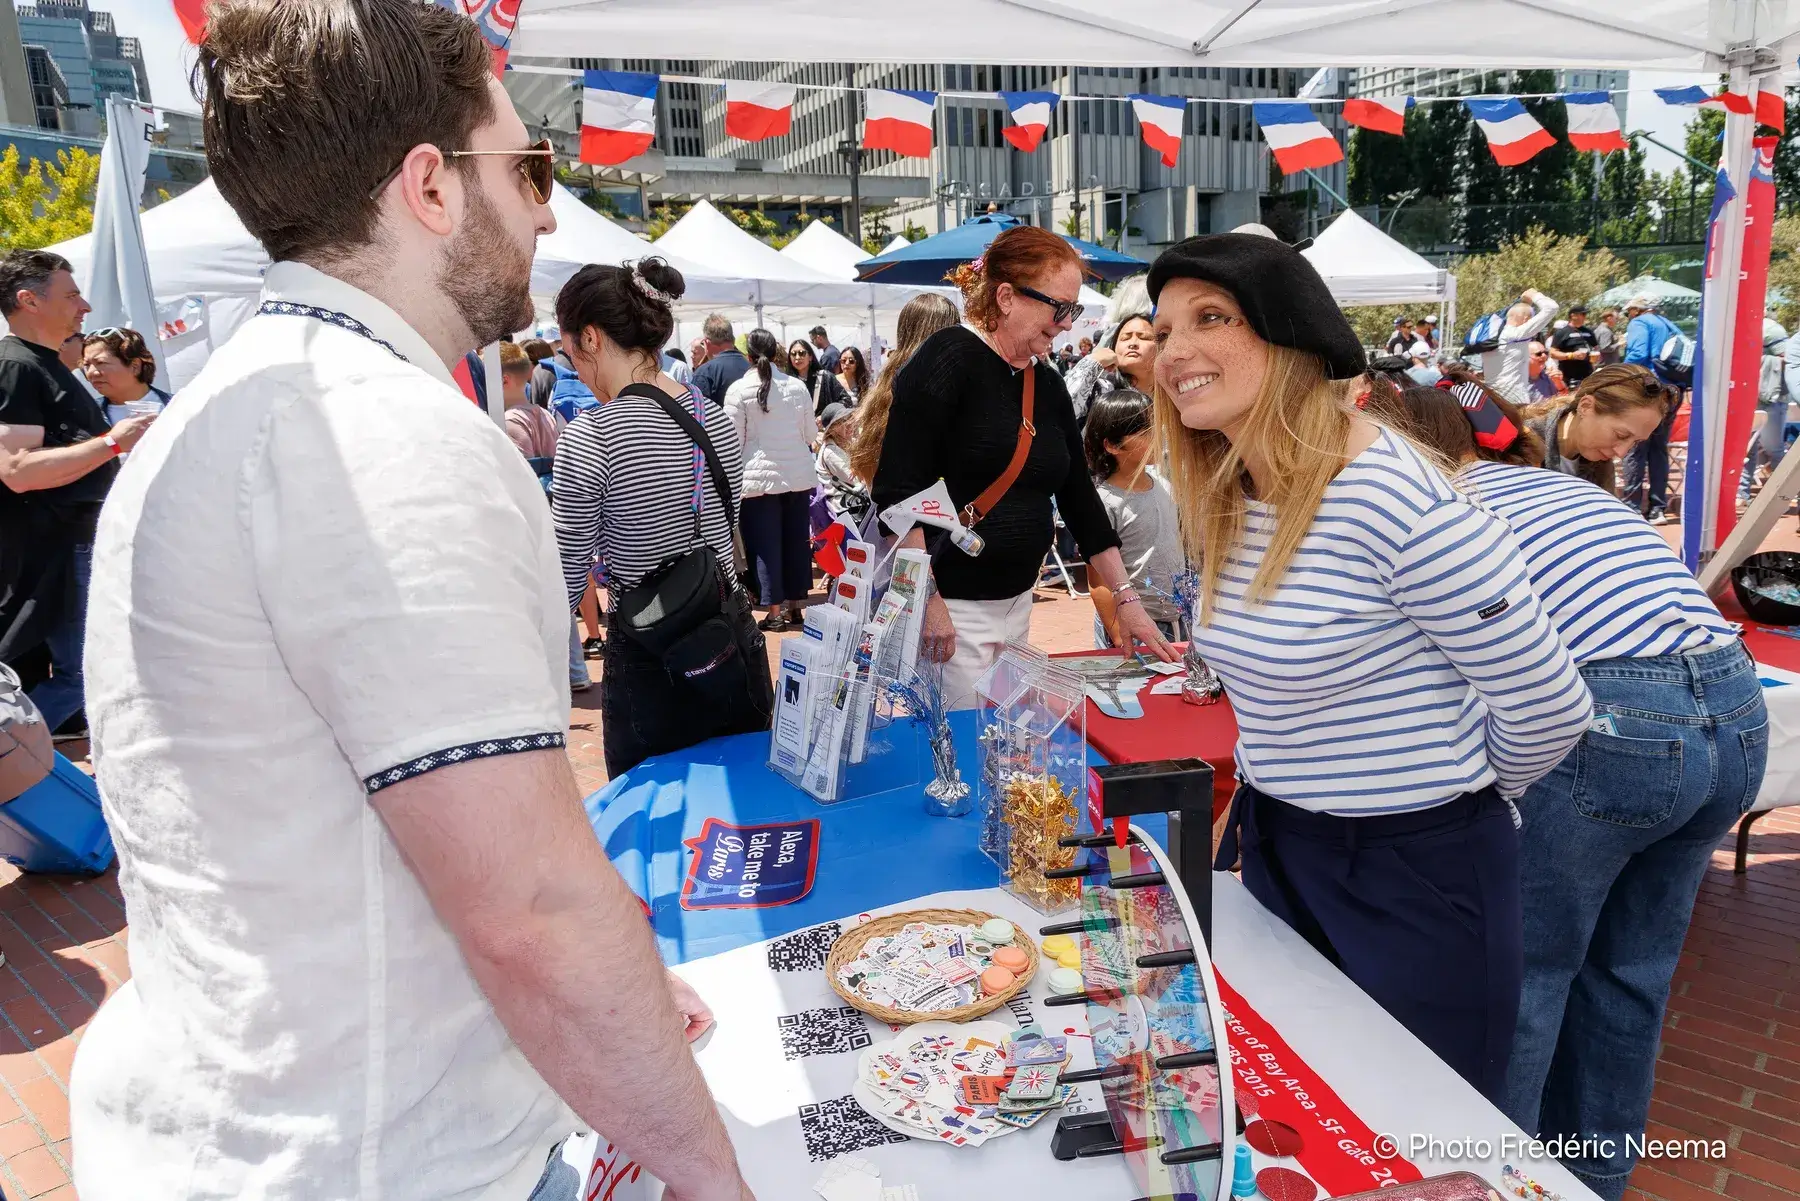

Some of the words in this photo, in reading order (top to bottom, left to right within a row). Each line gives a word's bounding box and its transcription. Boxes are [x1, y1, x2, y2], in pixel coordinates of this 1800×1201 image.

[707, 832, 744, 880] Paris
[747, 832, 771, 859] take
[773, 831, 803, 868] Alexa,
[742, 861, 762, 881] me
[738, 882, 761, 898] to
[968, 1076, 982, 1101] PARIS
[1237, 1067, 1275, 1097] 2015
[1245, 1037, 1269, 1050] of
[1257, 1052, 1287, 1077] Bay
[1280, 1076, 1316, 1110] Area
[1319, 1117, 1346, 1134] SF
[1338, 1139, 1376, 1166] Gate
